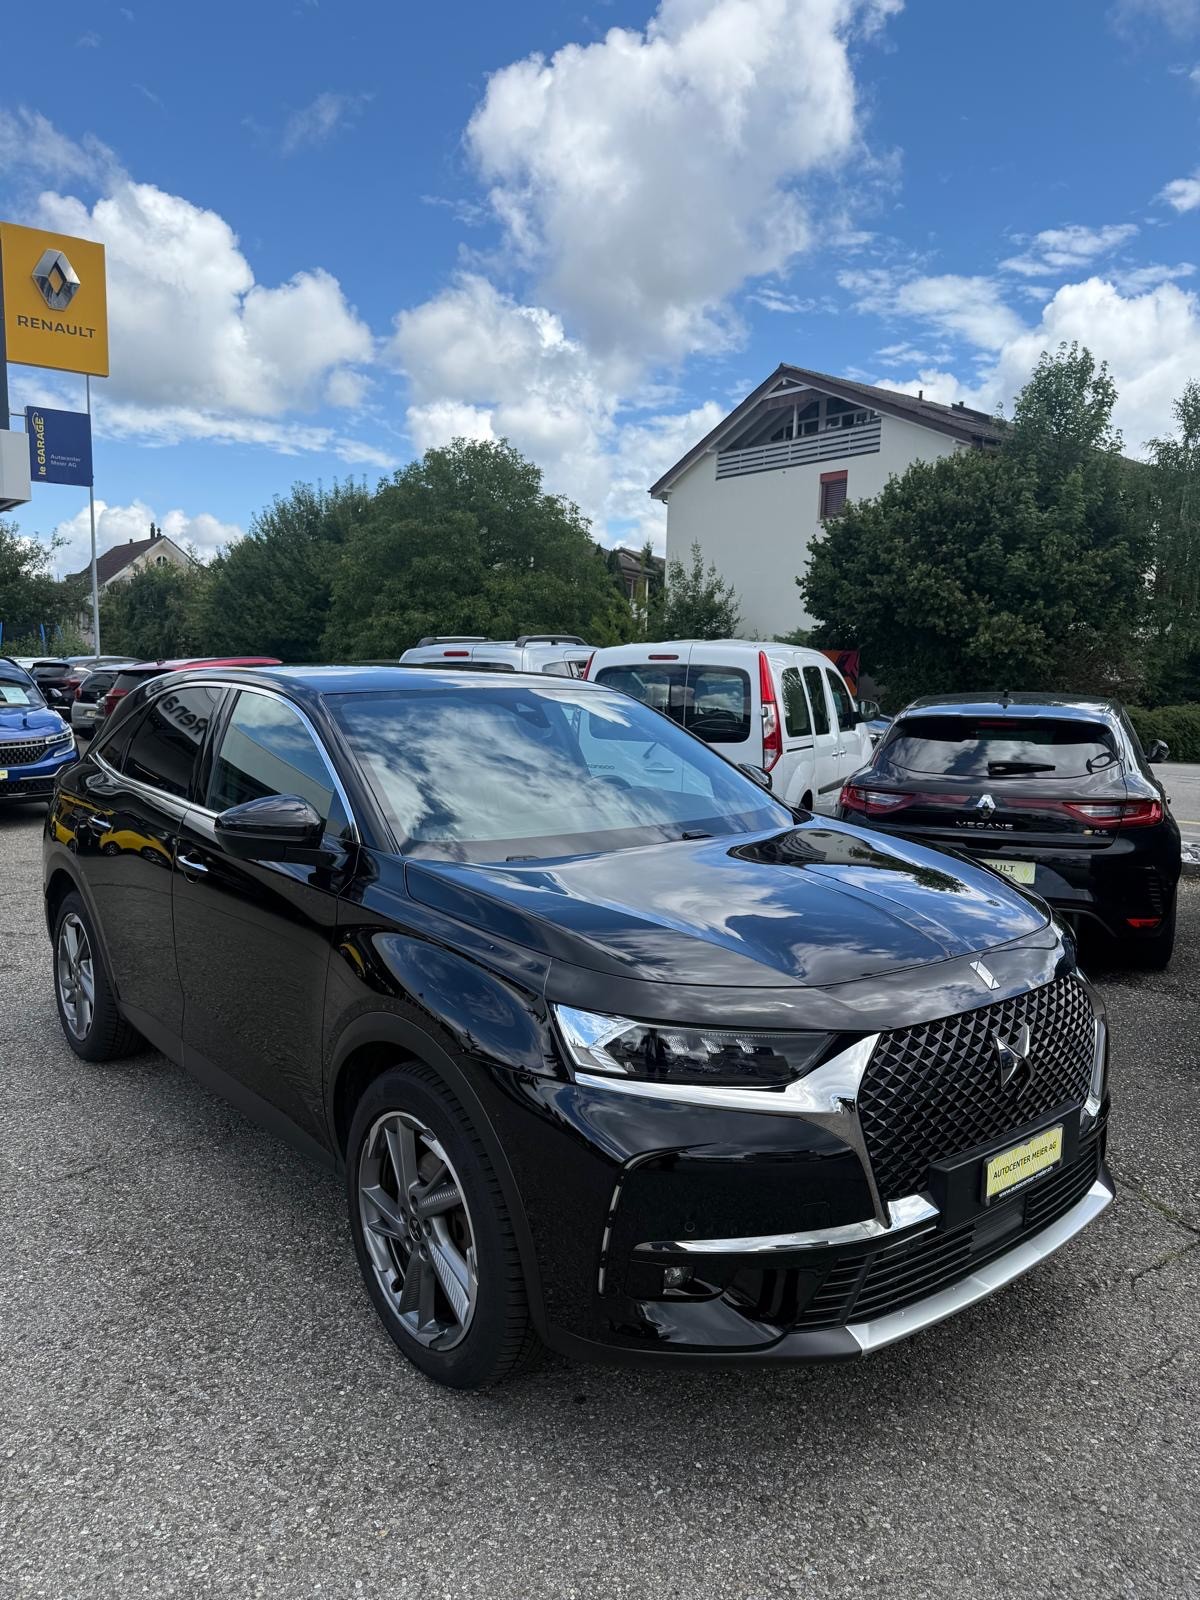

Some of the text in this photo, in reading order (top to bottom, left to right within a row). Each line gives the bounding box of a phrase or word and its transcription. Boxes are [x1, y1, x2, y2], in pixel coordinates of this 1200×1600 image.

[17, 314, 96, 339] RENAULT
[35, 416, 47, 476] le GARAGE
[50, 453, 81, 462] Autocenter
[955, 820, 1014, 831] MEGANE
[992, 1141, 1057, 1180] AUTOCENTER MEIER AG
